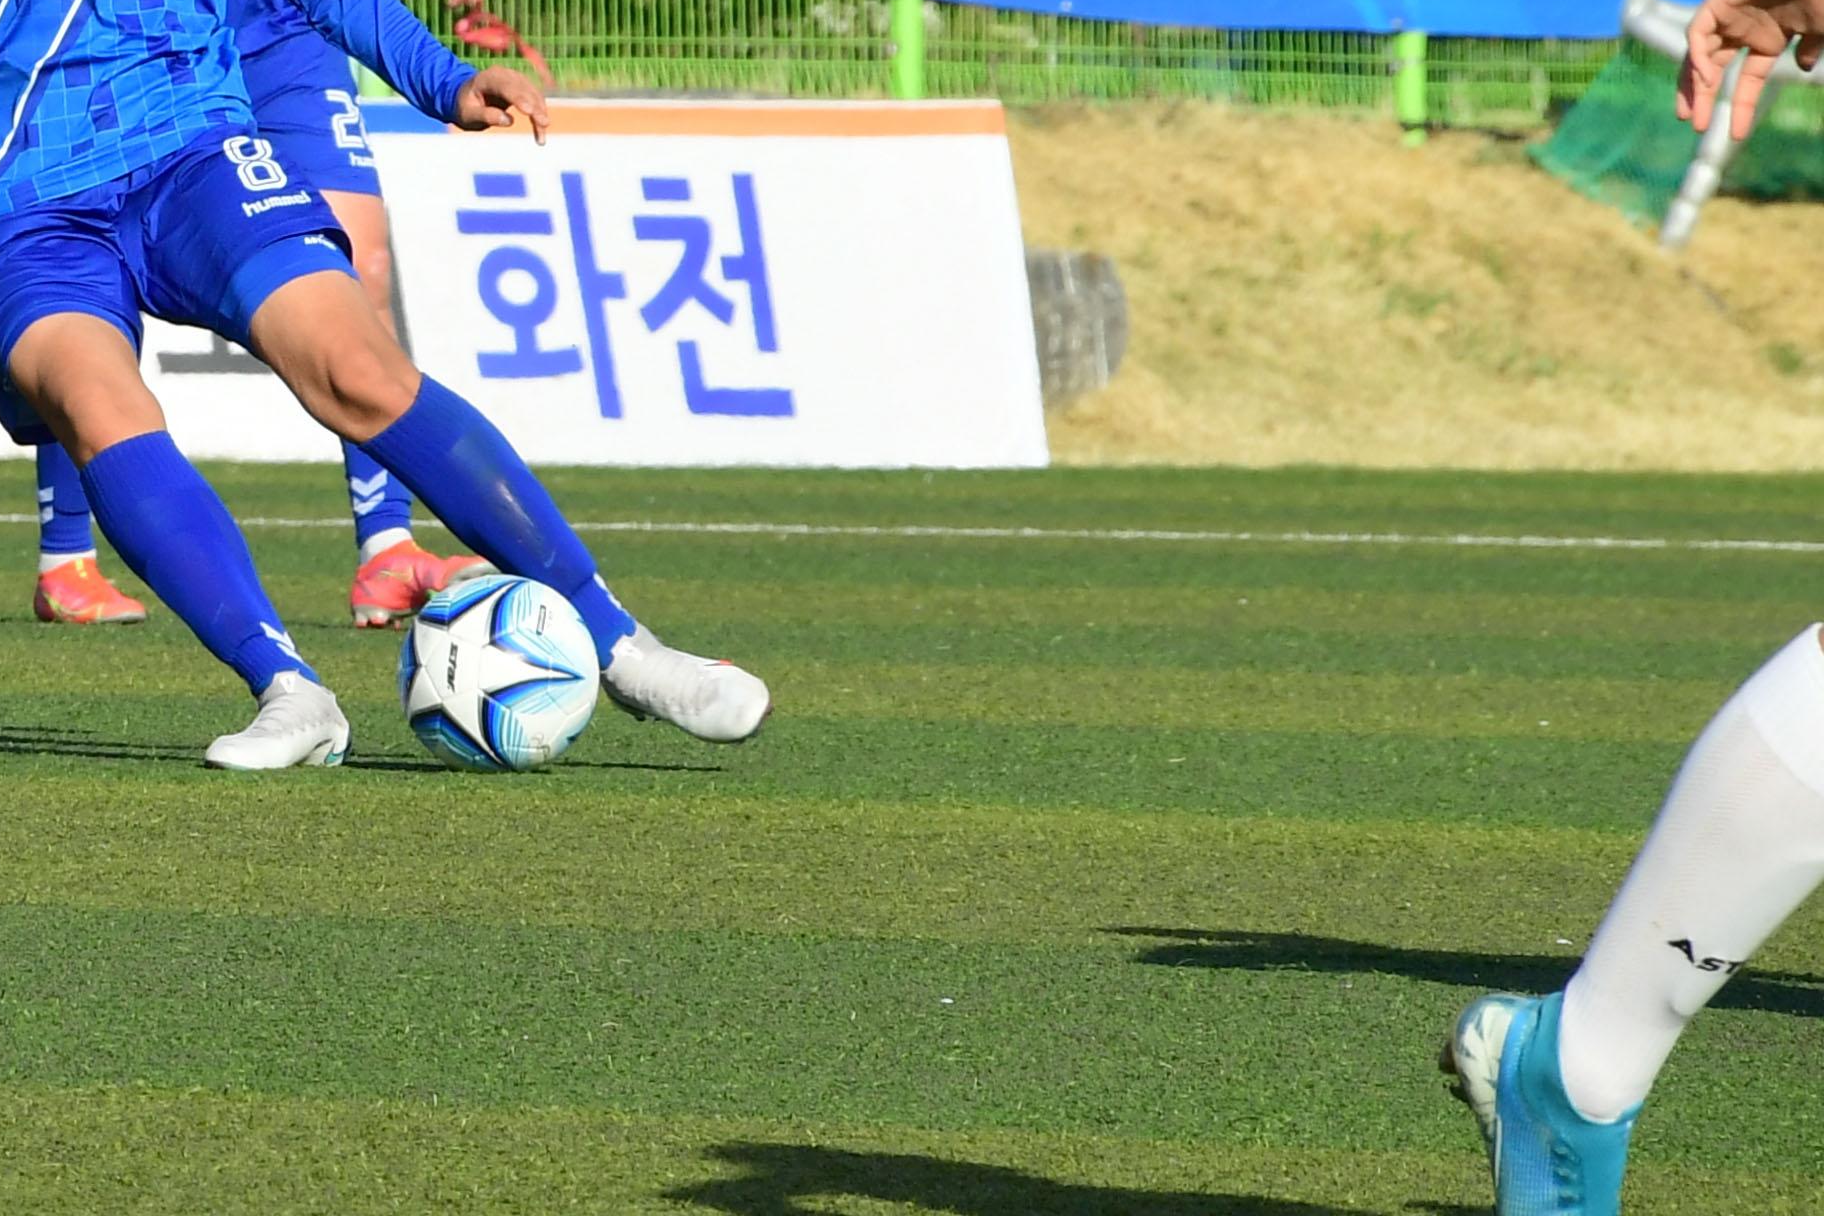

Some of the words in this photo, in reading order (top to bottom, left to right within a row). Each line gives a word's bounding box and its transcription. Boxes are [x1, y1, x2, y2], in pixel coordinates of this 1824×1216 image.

[223, 135, 288, 192] 8
[241, 190, 312, 218] hummel
[454, 170, 797, 421] 화천
[1667, 937, 1746, 975] AST
